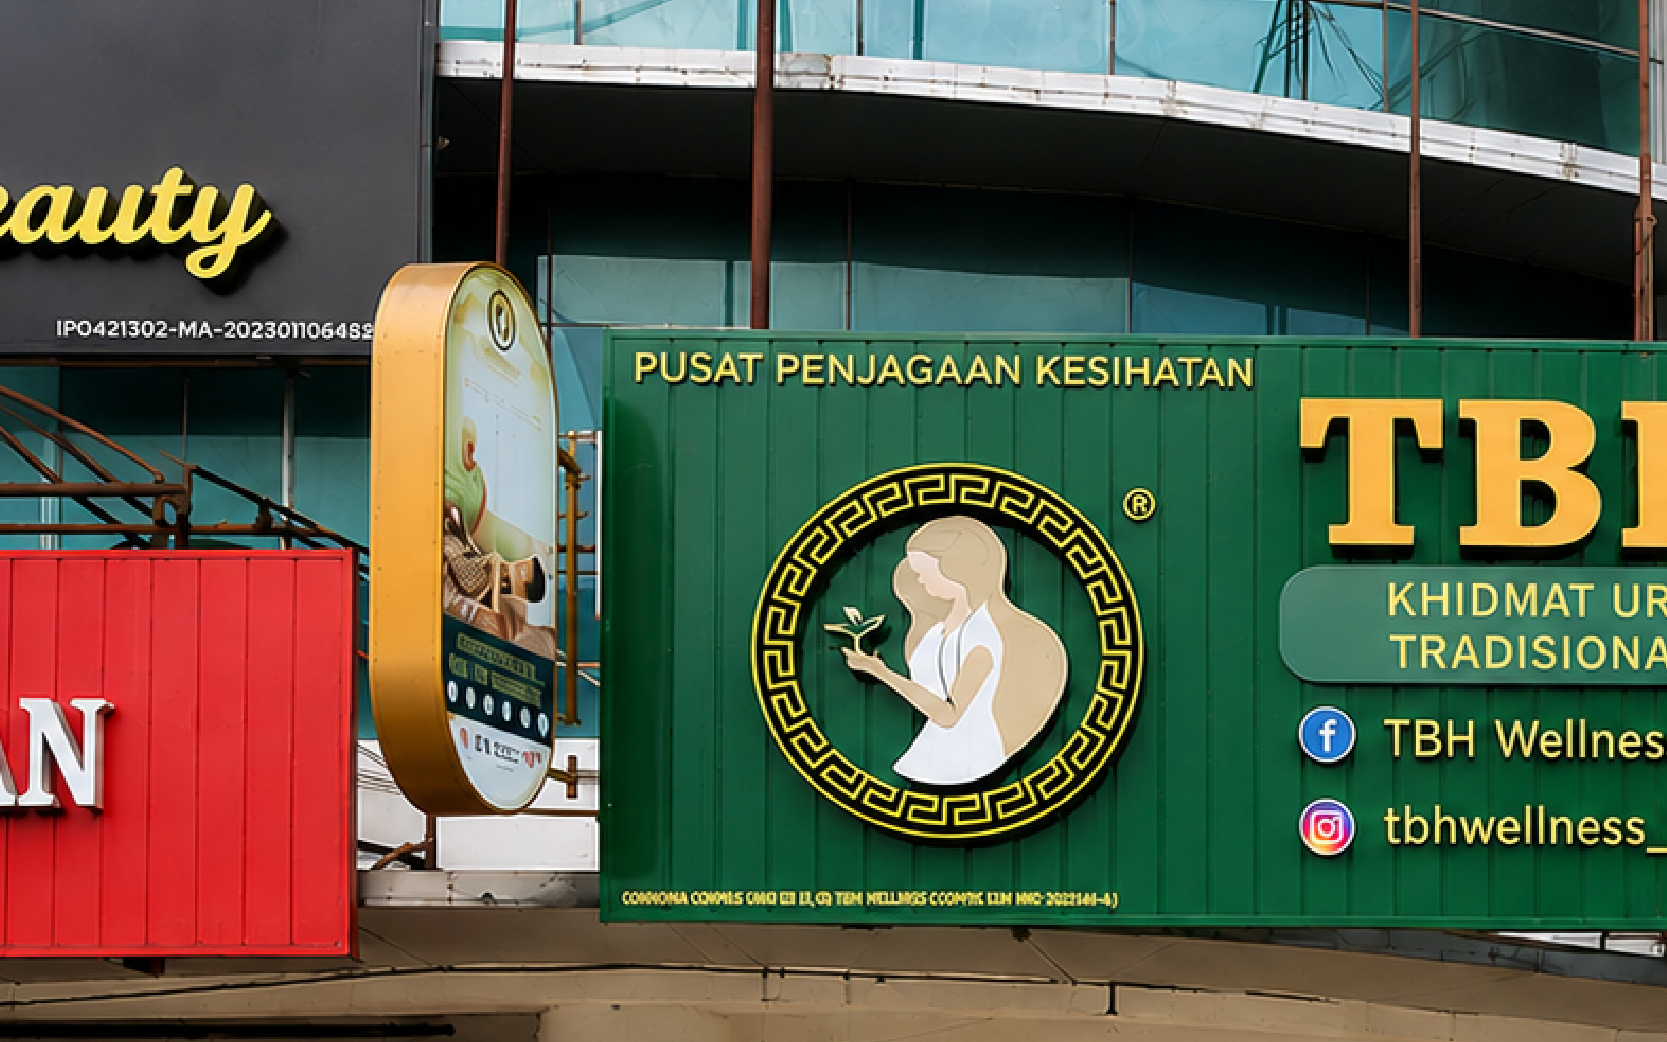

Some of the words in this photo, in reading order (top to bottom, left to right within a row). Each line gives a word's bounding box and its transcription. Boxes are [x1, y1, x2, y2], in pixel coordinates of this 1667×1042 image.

[635, 351, 764, 384] PUSAT
[777, 354, 1020, 386] PENJAGAAN
[1037, 356, 1252, 388] KESIHATAN
[1387, 581, 1595, 619] KHIDMAT
[1383, 718, 1475, 758] TBH
